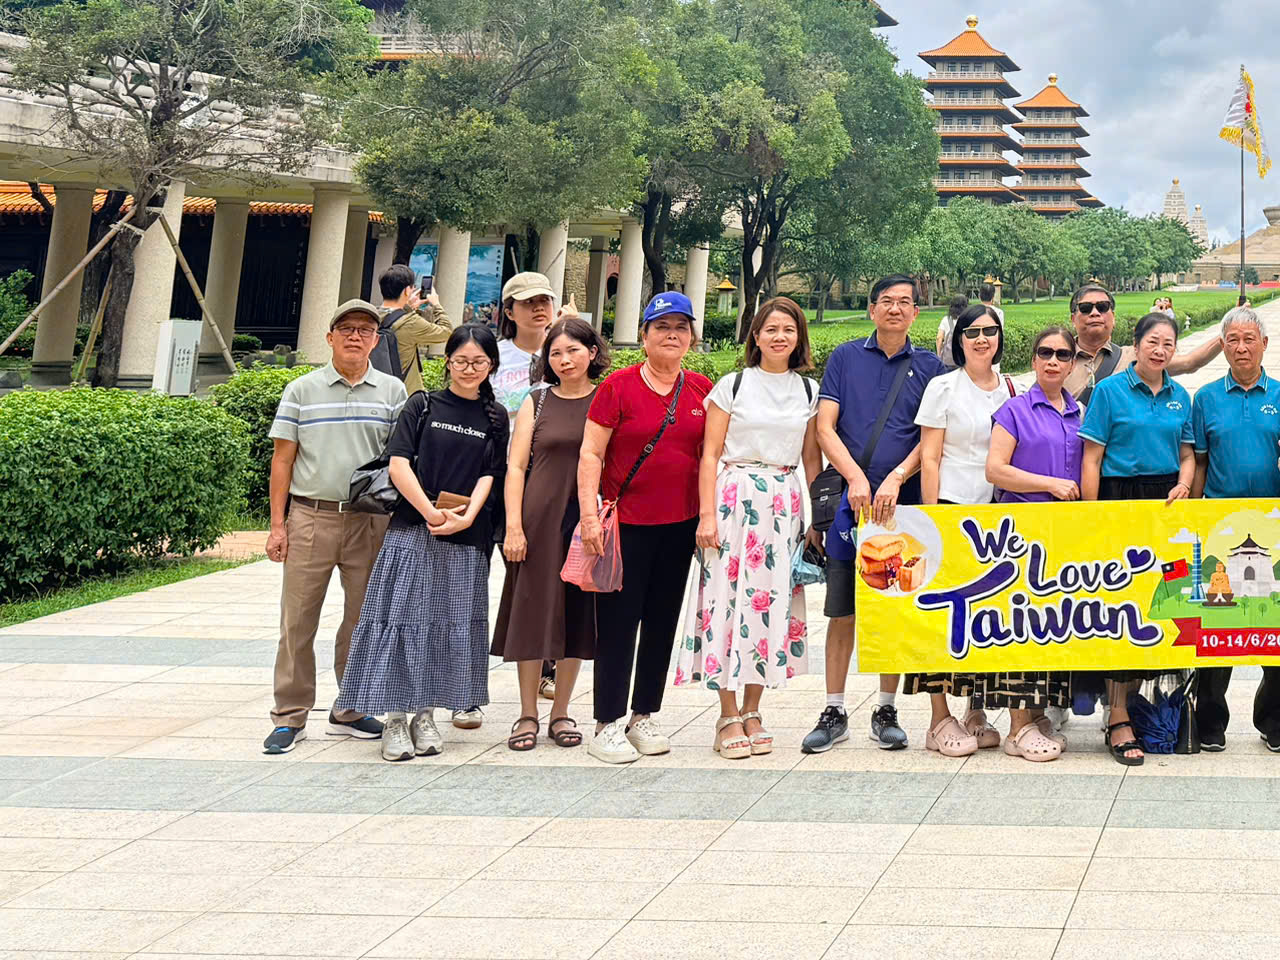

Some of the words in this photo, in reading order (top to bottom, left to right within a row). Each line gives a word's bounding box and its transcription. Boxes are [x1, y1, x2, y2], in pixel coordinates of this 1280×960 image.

[431, 421, 441, 429] so
[441, 423, 464, 434] much
[464, 426, 487, 440] closer
[961, 516, 1027, 563] We
[1027, 543, 1130, 593] Love
[917, 560, 1161, 656] Taiwan
